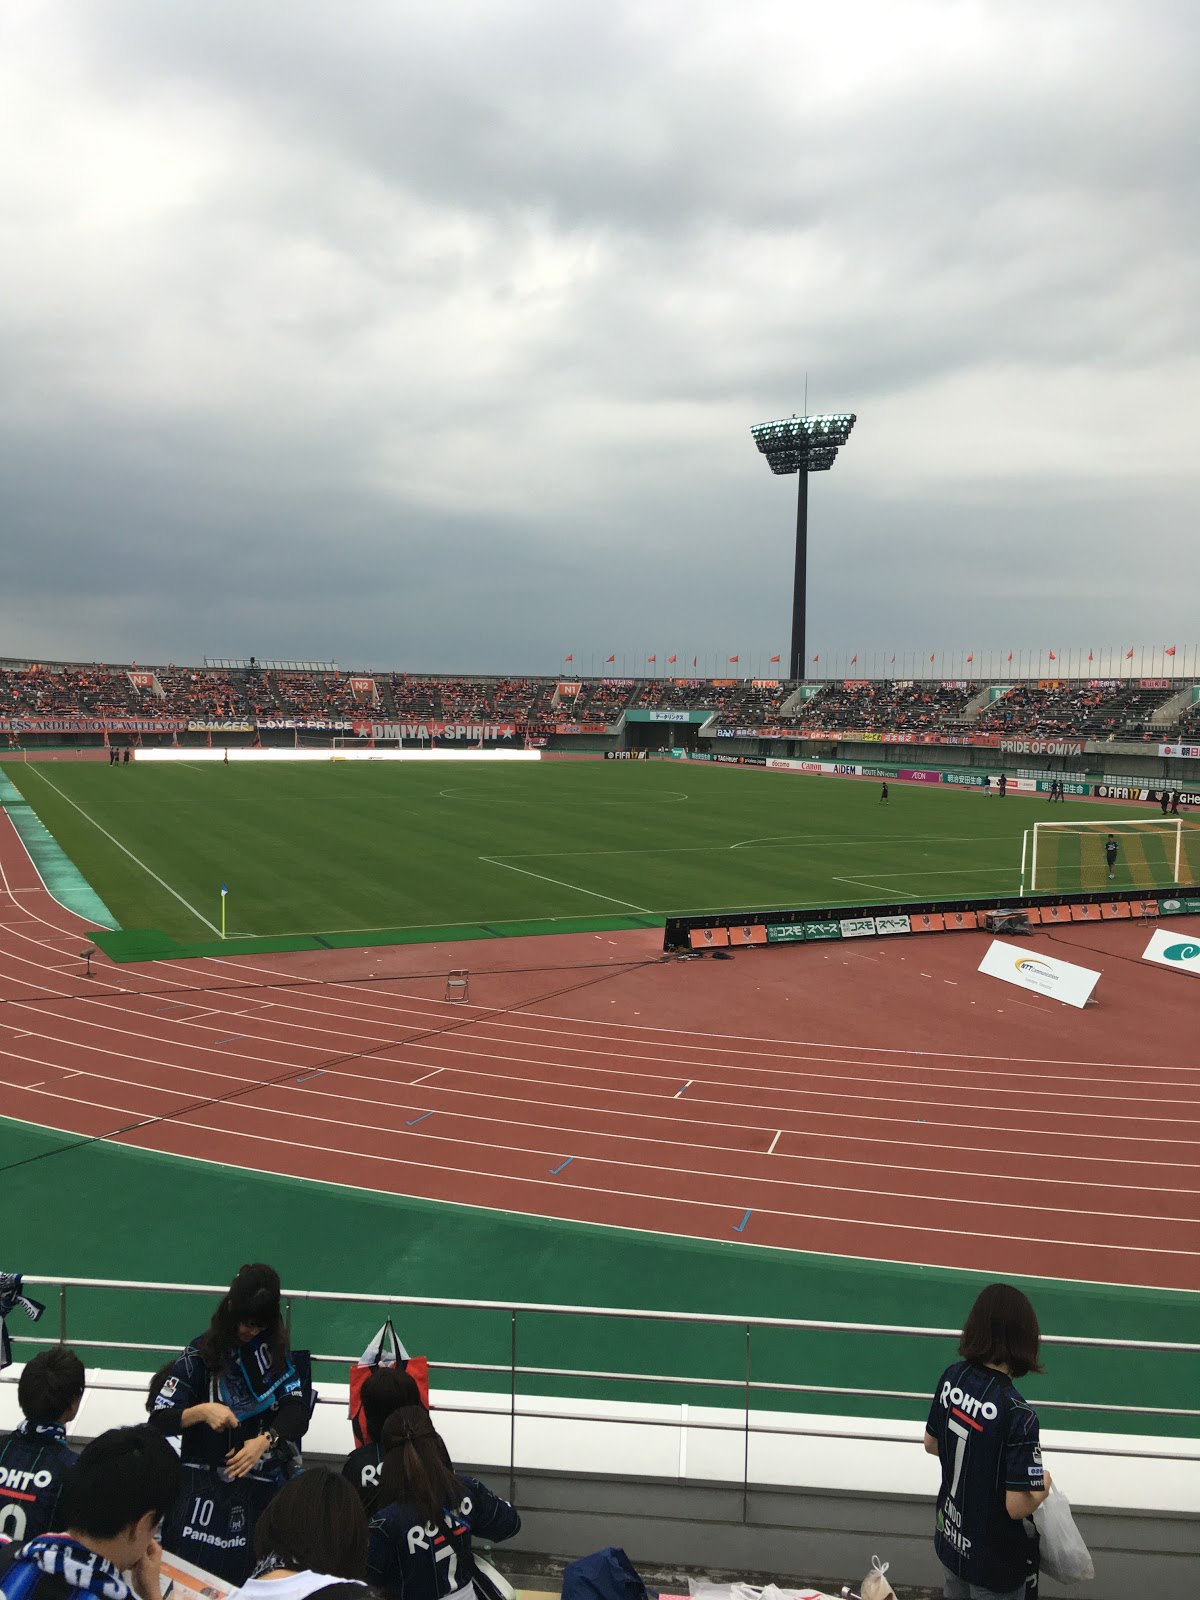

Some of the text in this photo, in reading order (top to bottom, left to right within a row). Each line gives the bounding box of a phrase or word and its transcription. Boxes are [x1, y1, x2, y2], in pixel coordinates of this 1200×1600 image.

[133, 675, 148, 684] N3
[355, 681, 368, 689] N2
[564, 685, 576, 694] N1
[35, 721, 81, 731] ARDIJA
[85, 721, 118, 731] LOVE
[121, 722, 158, 731] WITH
[159, 722, 186, 731] YOU
[257, 720, 296, 728] LOVE
[306, 721, 352, 730] PRIDE
[516, 724, 556, 734] ULTRAS
[444, 724, 500, 740] SPIRIT
[717, 728, 735, 737] BAN
[1000, 740, 1082, 756] PRIDE OF OMIYA
[615, 751, 638, 759] FIFA 17
[772, 760, 790, 768] docomo
[801, 762, 822, 771] Canon
[833, 764, 856, 775] AIDEM
[1108, 786, 1140, 800] FIFA 17
[807, 923, 838, 934] スペース
[878, 918, 908, 930] スペース
[940, 1381, 998, 1420] ROHTO
[948, 1418, 969, 1499] 7
[190, 1497, 215, 1527] 10
[944, 1496, 962, 1529] ENDO
[182, 1526, 247, 1549] Panasonic
[944, 1519, 972, 1552] SHIP
